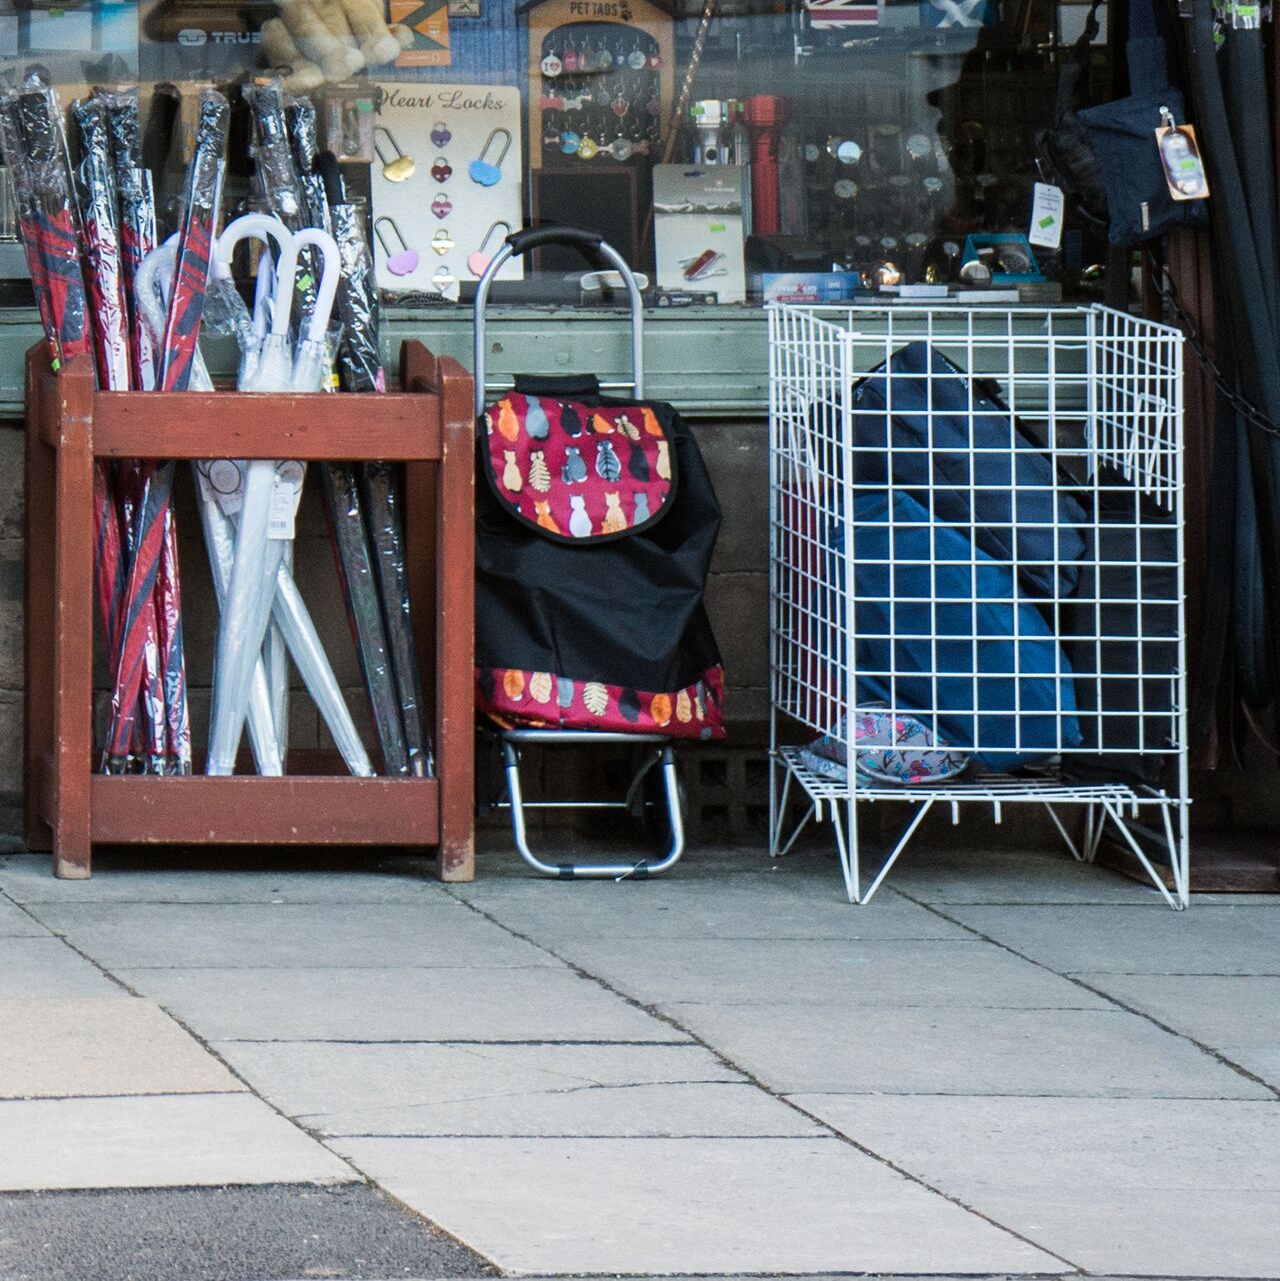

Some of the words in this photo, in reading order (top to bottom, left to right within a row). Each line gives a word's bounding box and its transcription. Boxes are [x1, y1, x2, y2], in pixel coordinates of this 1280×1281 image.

[570, 1, 590, 16] PET
[592, 2, 618, 17] TAGS
[381, 88, 434, 109] Heart
[437, 89, 507, 110] Locks
